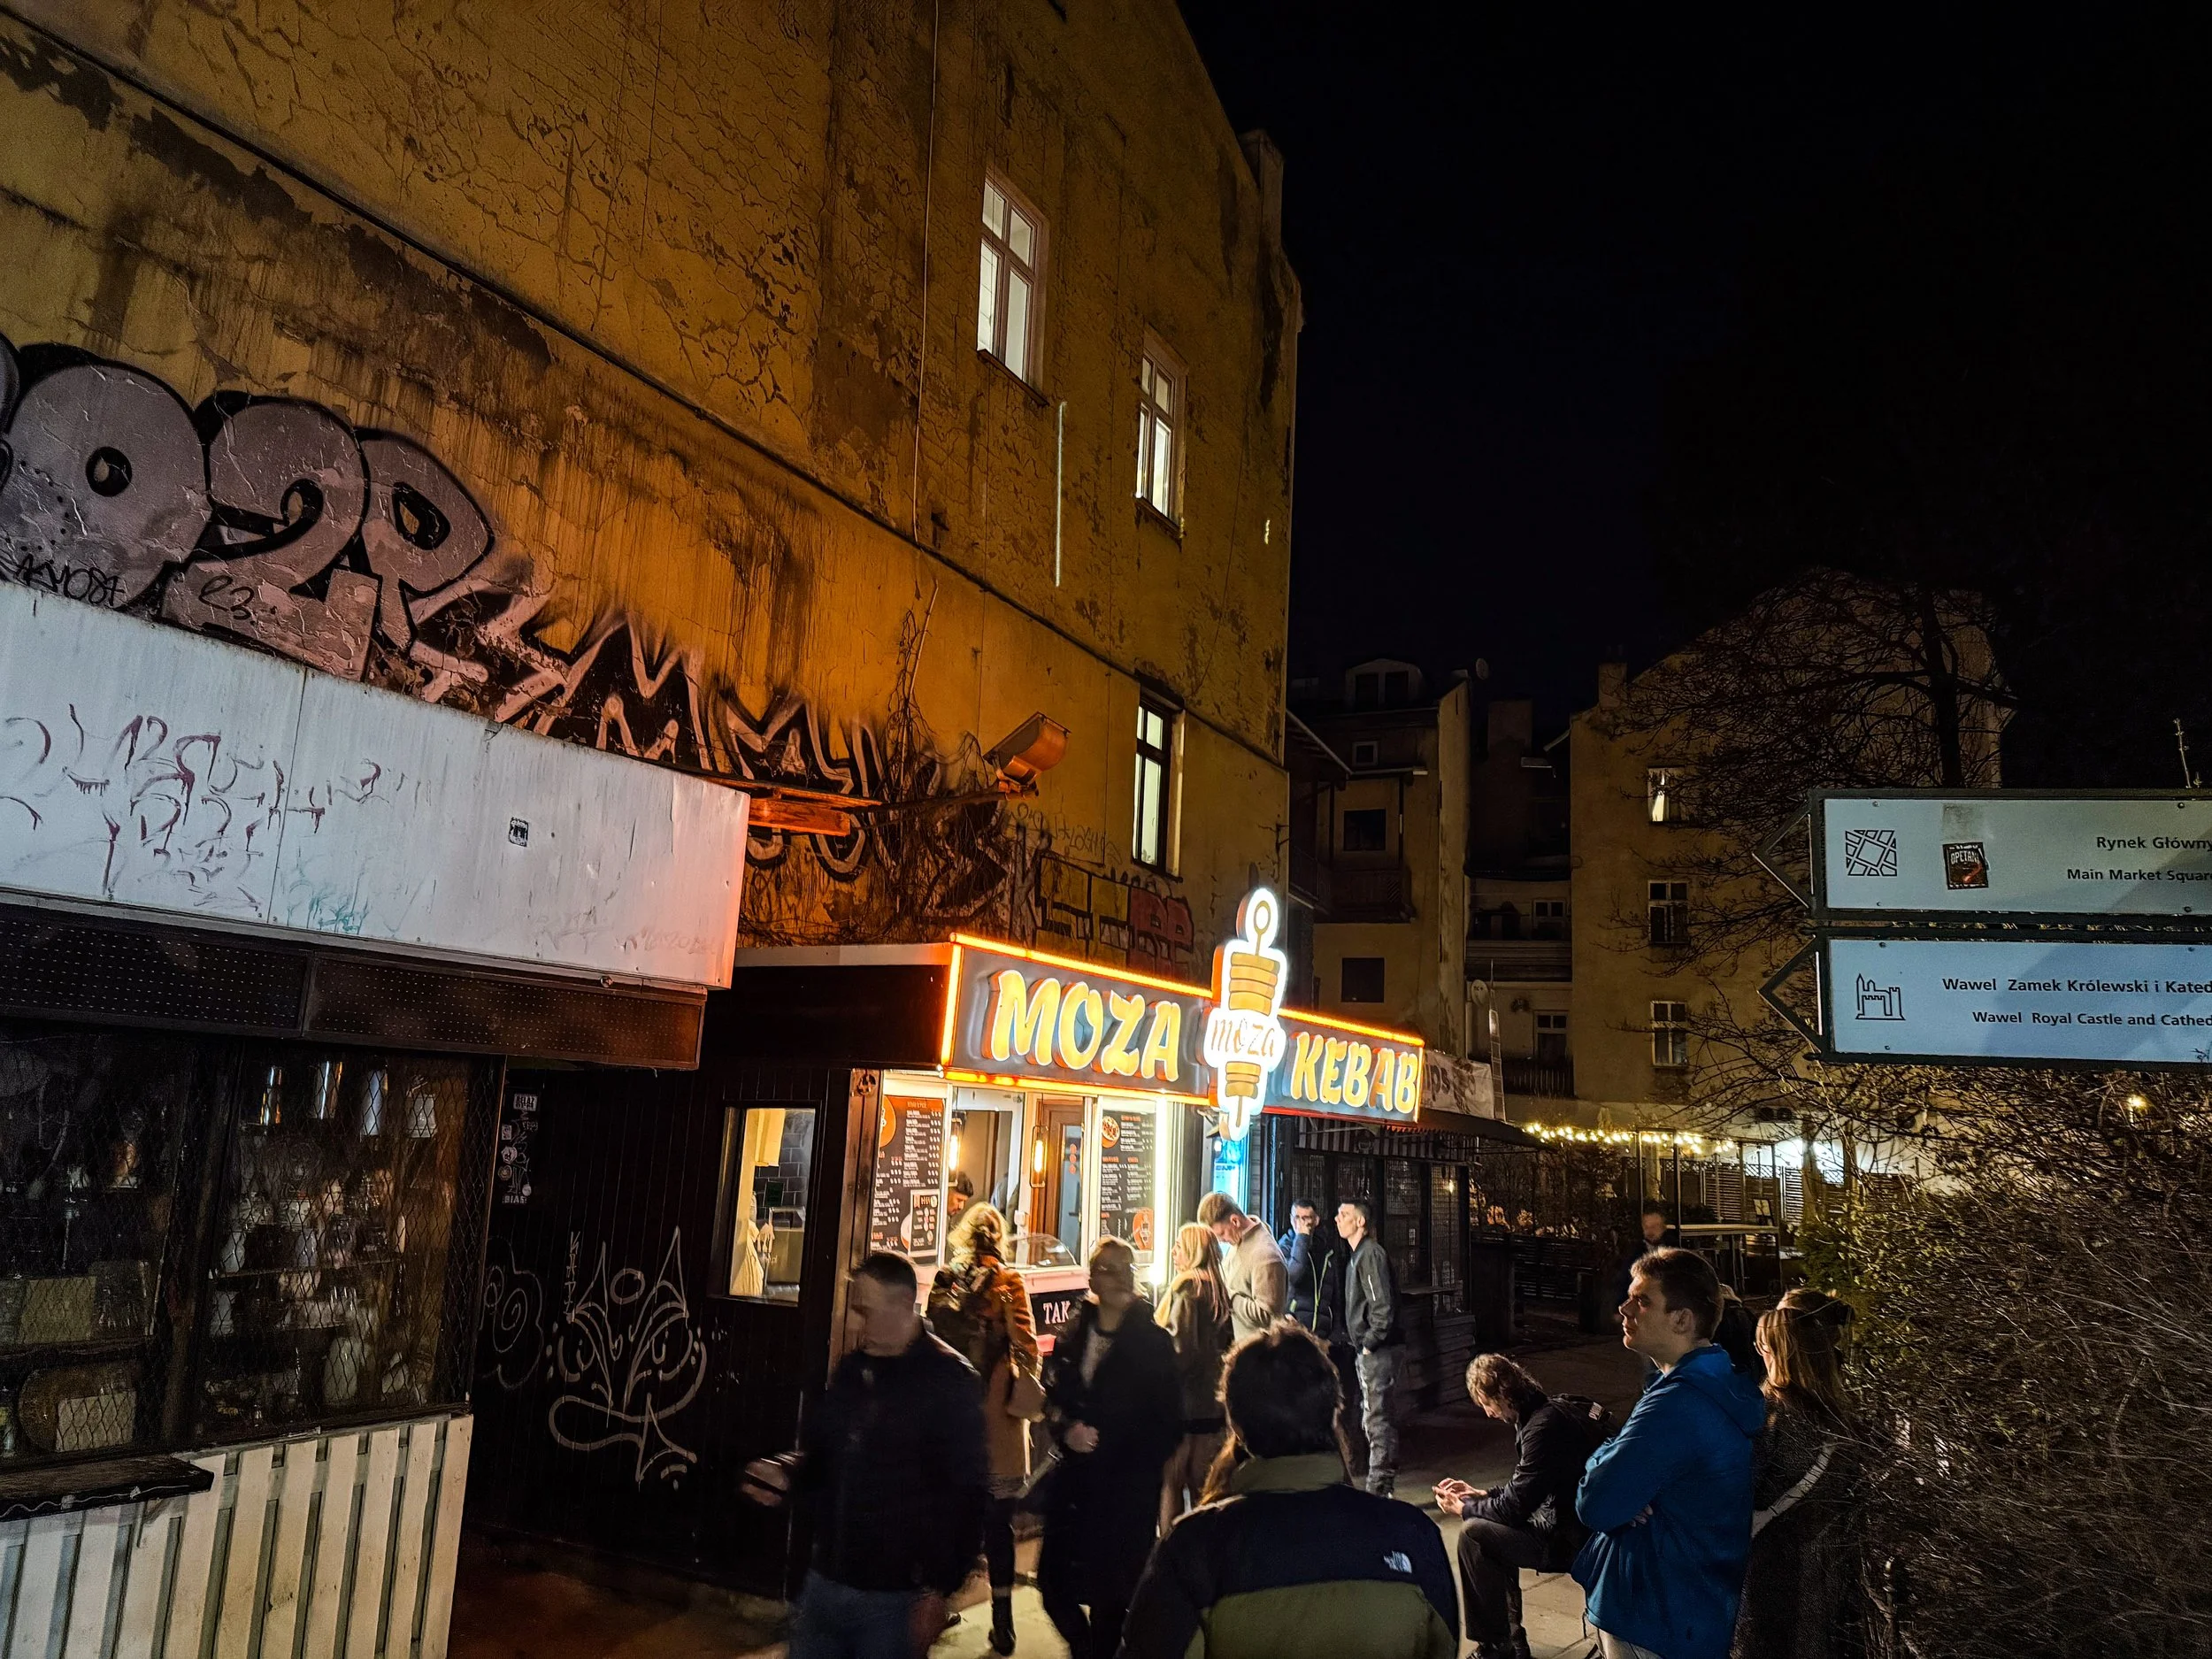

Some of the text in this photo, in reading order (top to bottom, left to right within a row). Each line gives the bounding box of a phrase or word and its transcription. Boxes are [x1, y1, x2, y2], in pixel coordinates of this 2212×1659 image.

[2096, 835, 2147, 851] Rynek
[2067, 868, 2212, 884] Main Market Squar
[1942, 978, 1997, 991] Wawel
[2007, 979, 2062, 992] Zamek
[2067, 979, 2149, 993] Królewski
[2154, 979, 2160, 993] i
[985, 969, 1182, 1082] MOZA
[1972, 1011, 2023, 1024] Wawel
[2032, 1012, 2072, 1026] Royal
[2077, 1013, 2123, 1025] Castle
[2127, 1014, 2155, 1025] and
[1290, 1031, 1417, 1114] KEBAB
